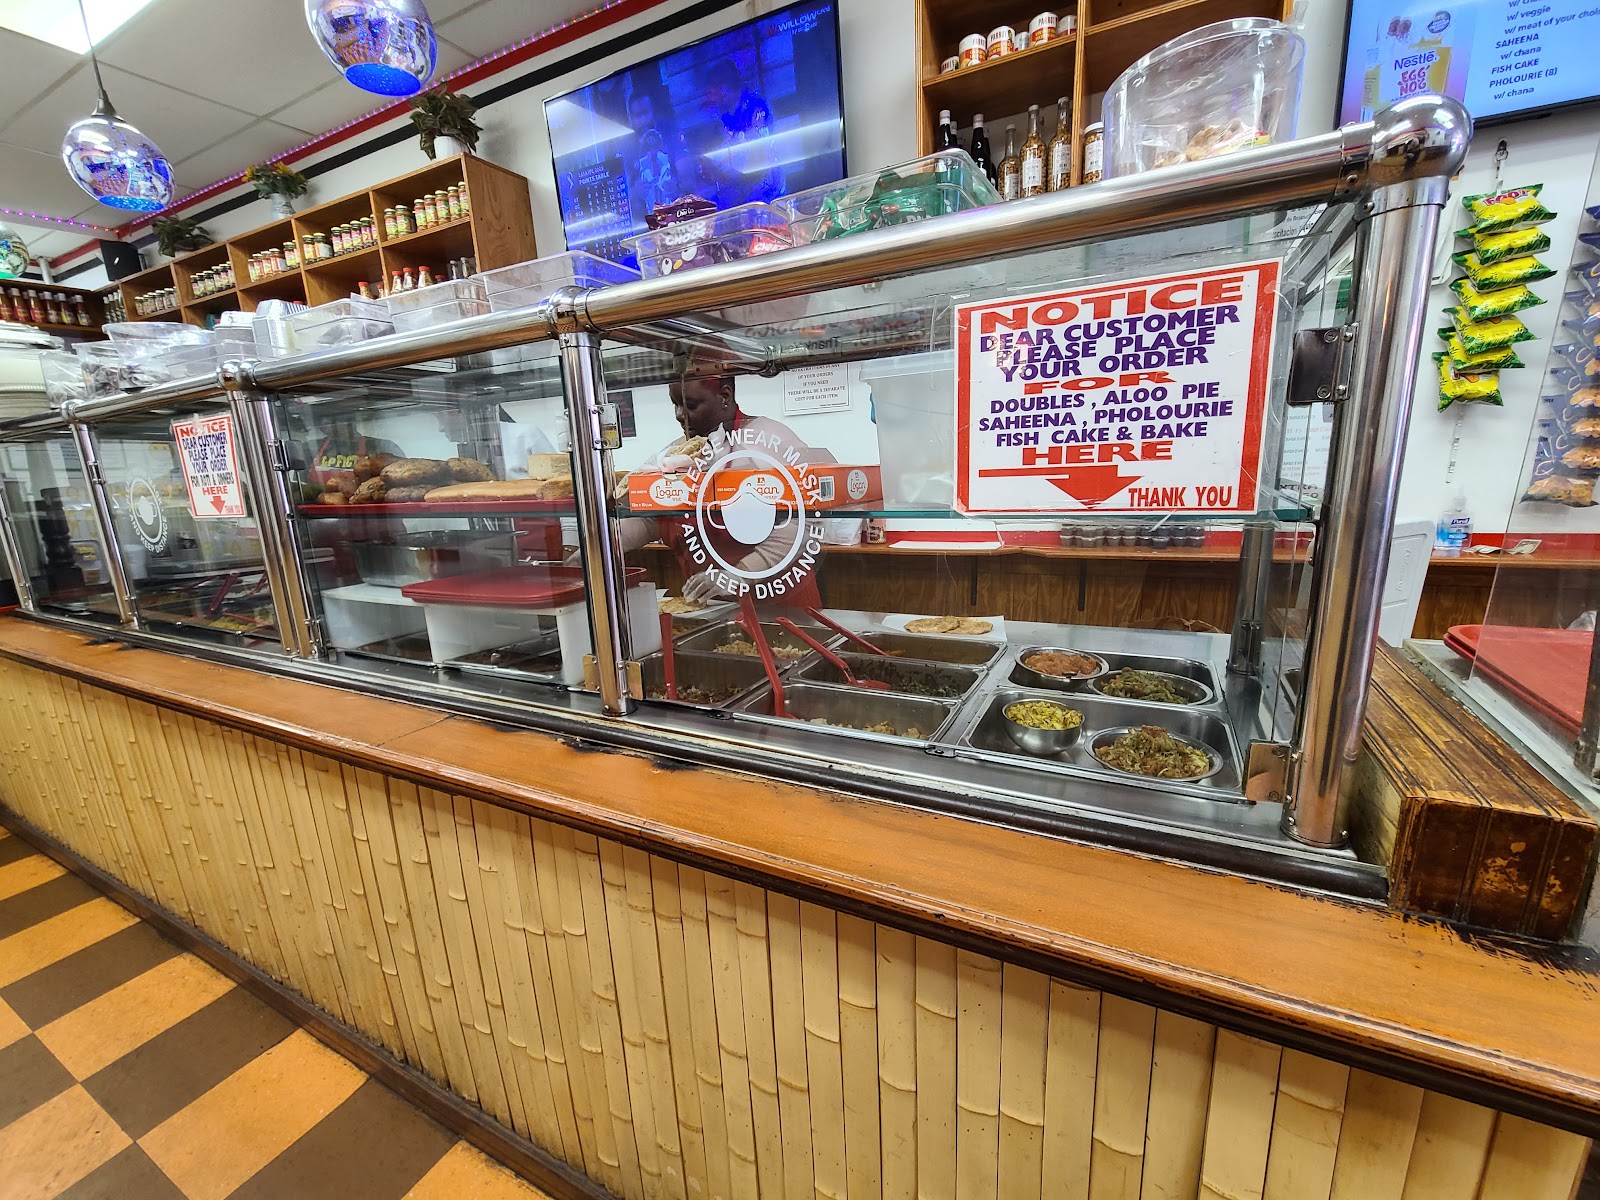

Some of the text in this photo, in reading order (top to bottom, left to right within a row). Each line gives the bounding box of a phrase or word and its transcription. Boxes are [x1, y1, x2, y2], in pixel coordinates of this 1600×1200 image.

[778, 10, 817, 32] WILLOW
[1520, 5, 1551, 18] veggie
[1518, 20, 1541, 32] meat
[1544, 17, 1553, 26] of
[1555, 13, 1576, 26] your
[1495, 33, 1539, 49] SAHEENA
[1514, 46, 1542, 57] chana
[1401, 66, 1426, 83] EGG
[1491, 58, 1540, 75] FISH CAKE
[1400, 78, 1427, 96] NOG
[1489, 70, 1543, 88] PHOLOURIE
[1507, 87, 1535, 98] chana
[980, 276, 1245, 334] NOTICE
[980, 305, 1241, 353] DEAR CUSTOMER
[996, 326, 1217, 367] PLEASE PLACE
[1000, 347, 1209, 383] YOUR ORDER
[1023, 370, 1177, 395] FOR
[990, 393, 1085, 414] DOUBLES
[1103, 387, 1168, 406] ALOO
[1182, 382, 1220, 400] PIE
[979, 412, 1077, 432] SAHEENA
[1094, 400, 1234, 424] PHOLOURIE
[182, 431, 228, 451] DEAR CUSTOMER
[996, 422, 1208, 447] FISH CAKE & BAKE
[188, 446, 227, 461] PLEASE PLACE
[1022, 440, 1173, 466] HERE
[210, 459, 228, 472] ORDER
[725, 428, 782, 453] WEAR
[782, 445, 825, 506] MASK
[202, 486, 228, 496] HERE
[1128, 486, 1233, 508] THANK YOU
[681, 523, 825, 600] AND KEEP DISTANCE
